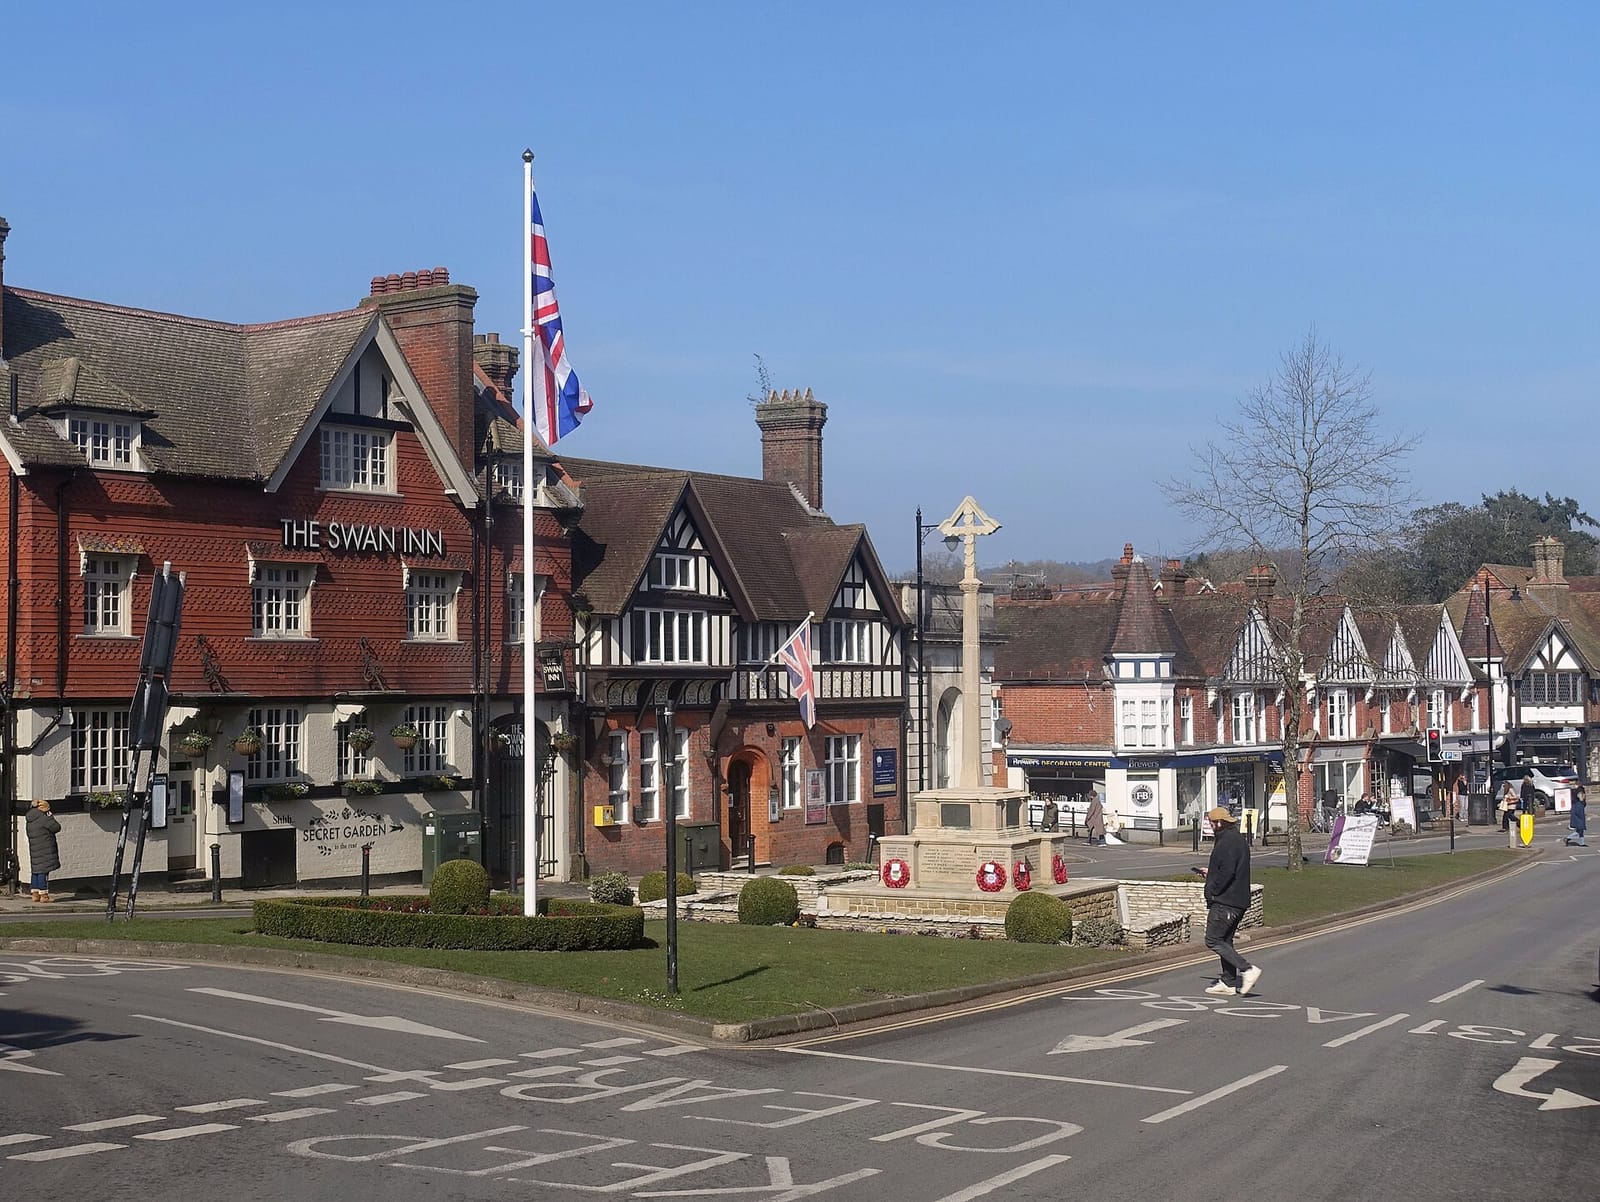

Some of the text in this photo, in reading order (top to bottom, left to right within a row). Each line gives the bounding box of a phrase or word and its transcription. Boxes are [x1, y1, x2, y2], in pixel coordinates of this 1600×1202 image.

[280, 518, 442, 555] THE SWAN INN
[543, 665, 562, 674] SWAN
[547, 673, 560, 681] INN
[511, 724, 523, 736] THE
[509, 744, 524, 757] INN
[1012, 757, 1040, 766] Brewers
[1128, 758, 1160, 768] Brewers
[303, 824, 386, 842] SECRET GARDEN
[1062, 989, 1378, 1023] A286
[500, 1068, 1085, 1154] CLEAR
[286, 1125, 883, 1202] KEEP
